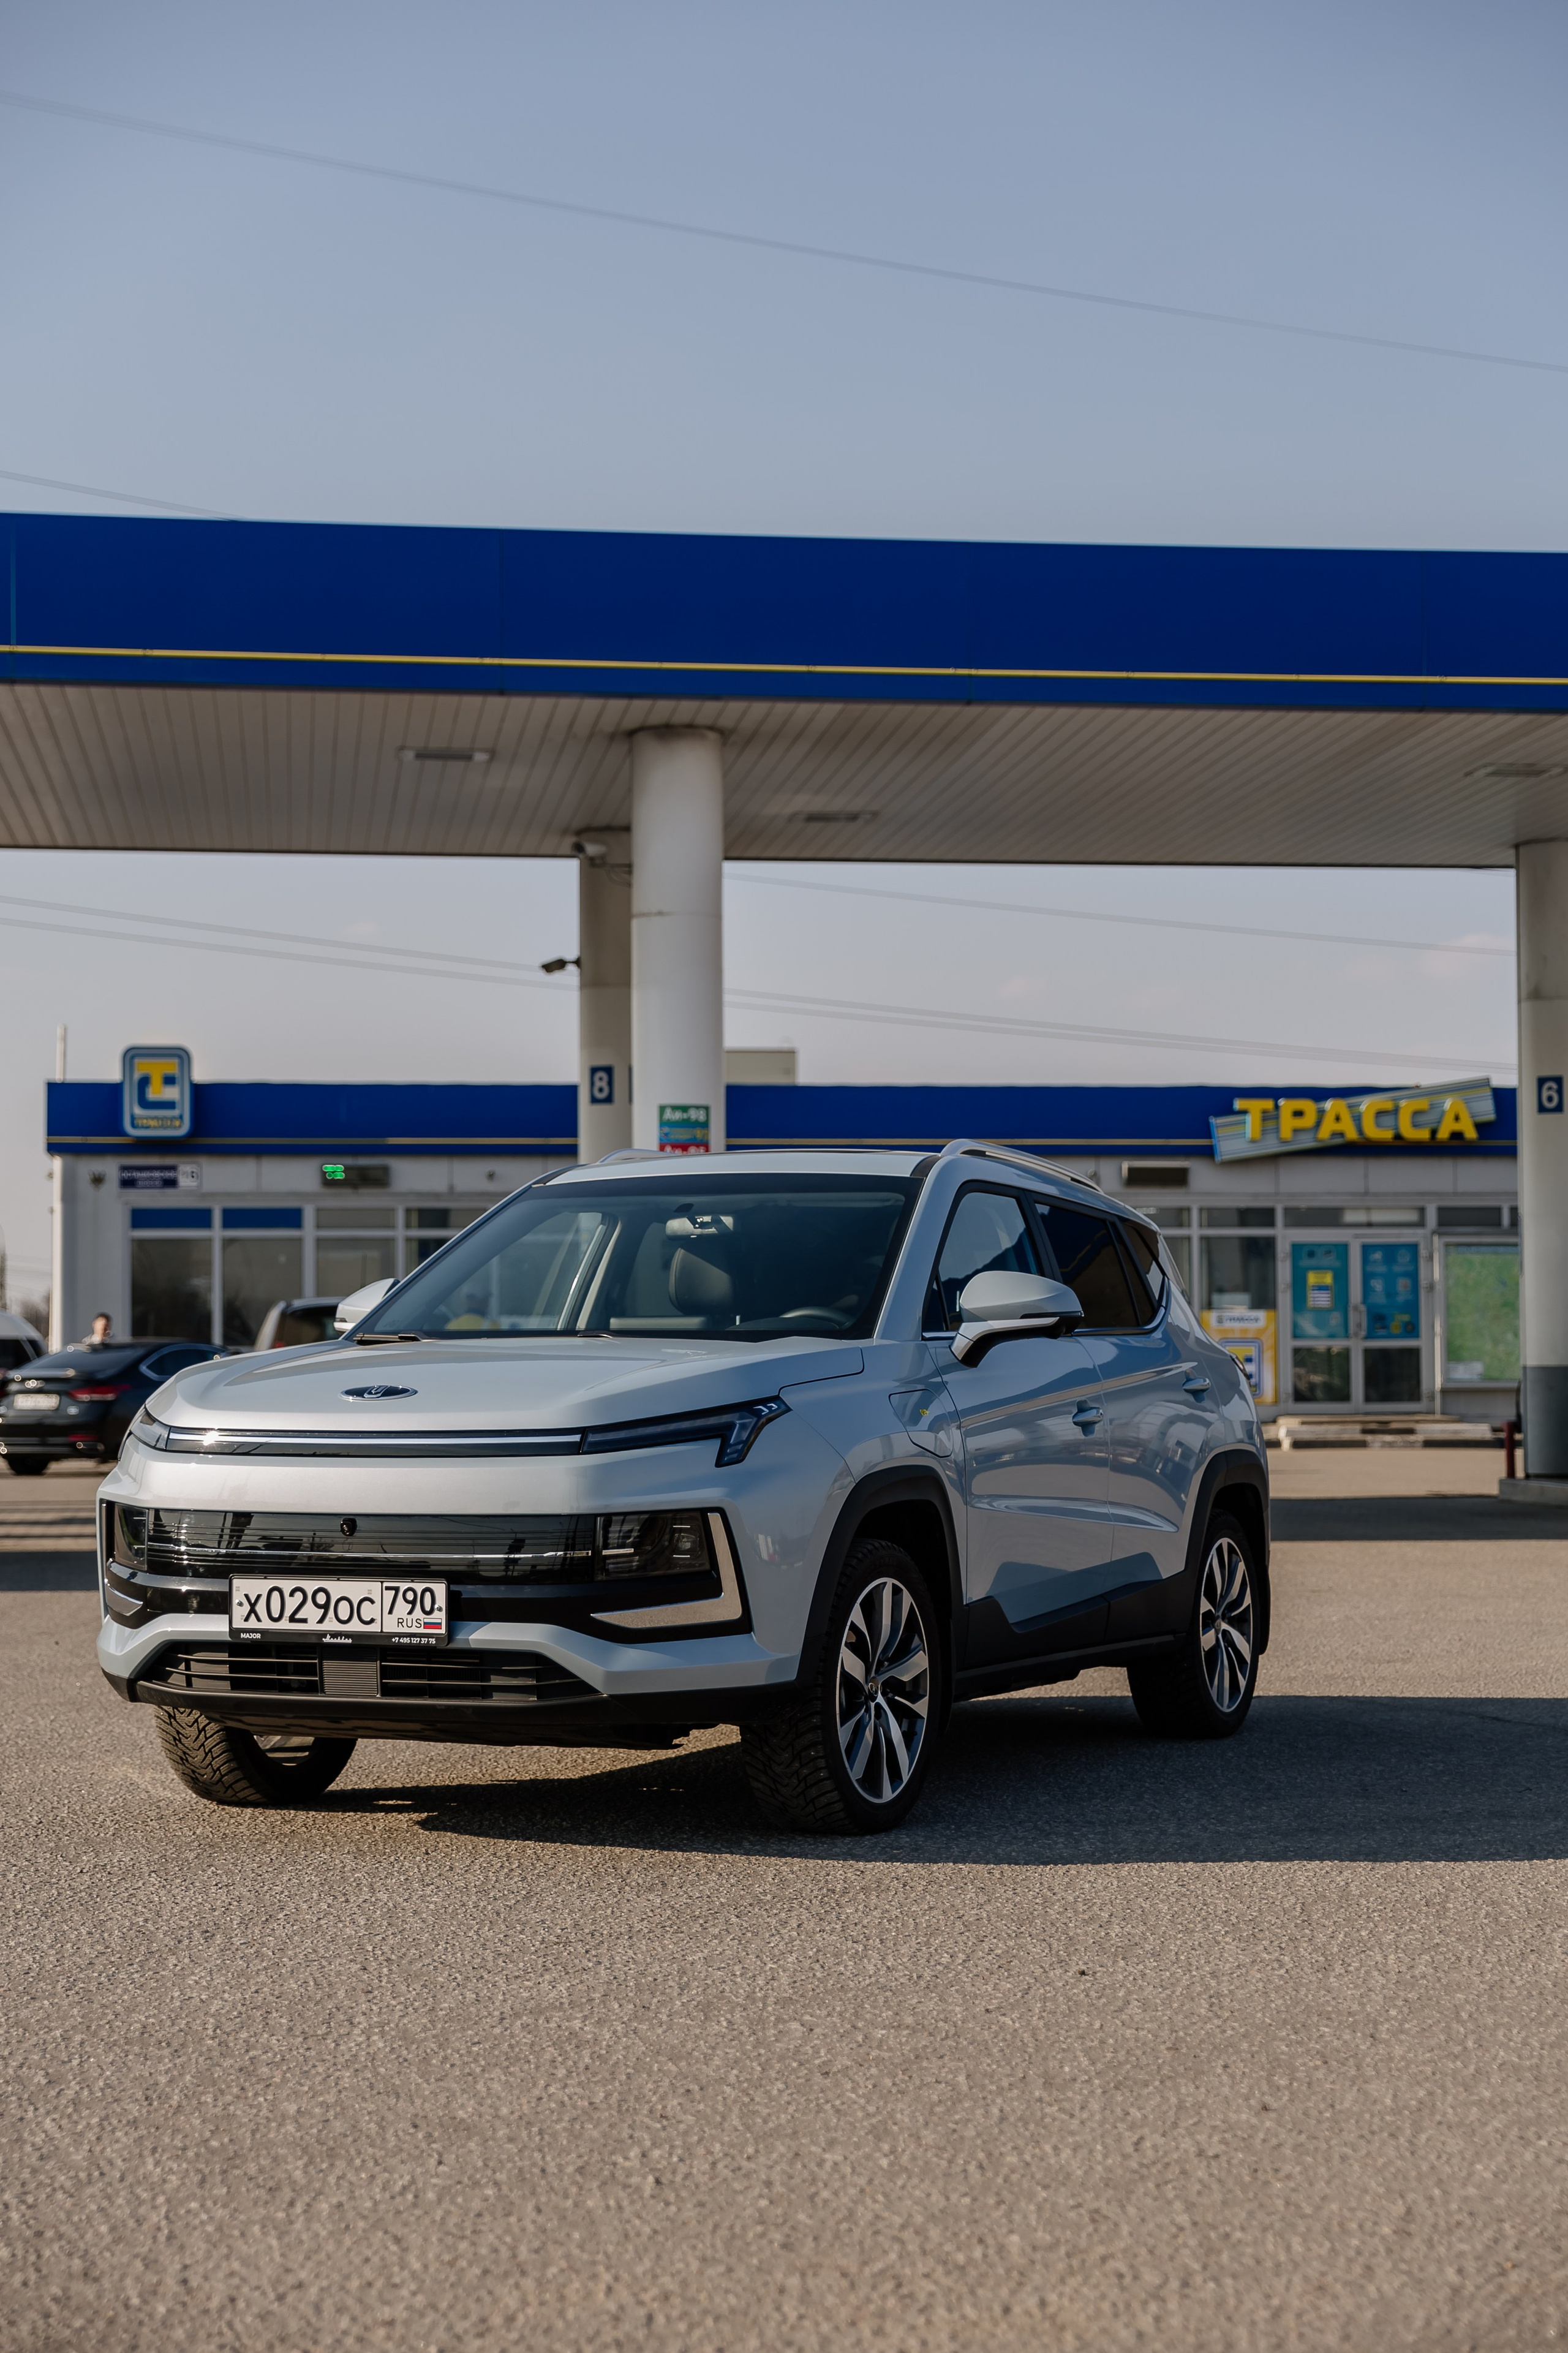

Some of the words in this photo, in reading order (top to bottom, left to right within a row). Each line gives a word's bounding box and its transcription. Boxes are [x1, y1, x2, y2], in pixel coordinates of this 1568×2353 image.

[593, 1071, 609, 1100] 8
[1540, 1080, 1559, 1109] 6
[1234, 1097, 1479, 1142] ТРАССА
[243, 1585, 376, 1626] Х029ОС
[384, 1586, 437, 1616] 790
[397, 1618, 422, 1628] RUS
